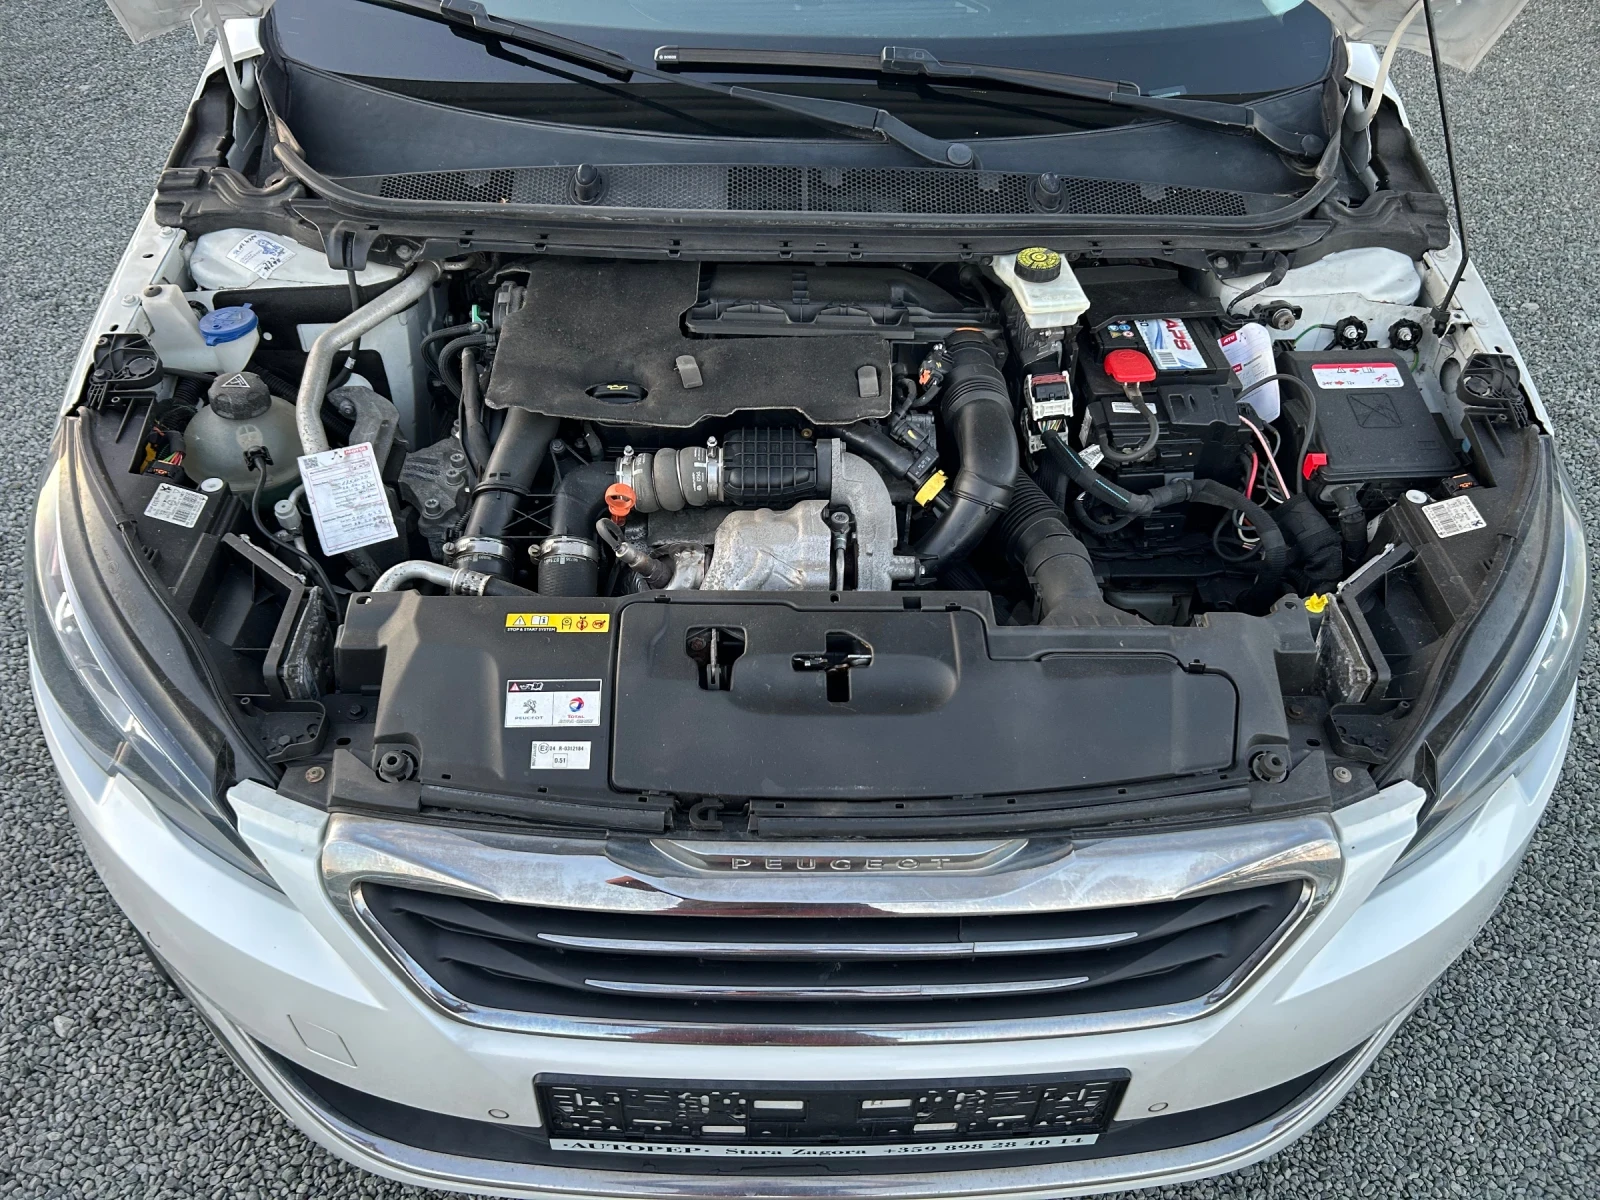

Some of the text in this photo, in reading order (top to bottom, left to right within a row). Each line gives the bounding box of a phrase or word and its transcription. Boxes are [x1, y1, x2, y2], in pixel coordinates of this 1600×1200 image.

[1162, 318, 1192, 350] APS
[1222, 335, 1235, 344] ATU
[731, 857, 951, 871] PEUGEOT
[791, 1149, 867, 1157] Zagora
[883, 1145, 937, 1154] +359
[944, 1142, 984, 1151] 898
[990, 1141, 1017, 1149] 28
[1023, 1138, 1051, 1146] 40
[1060, 1136, 1084, 1144] 14
